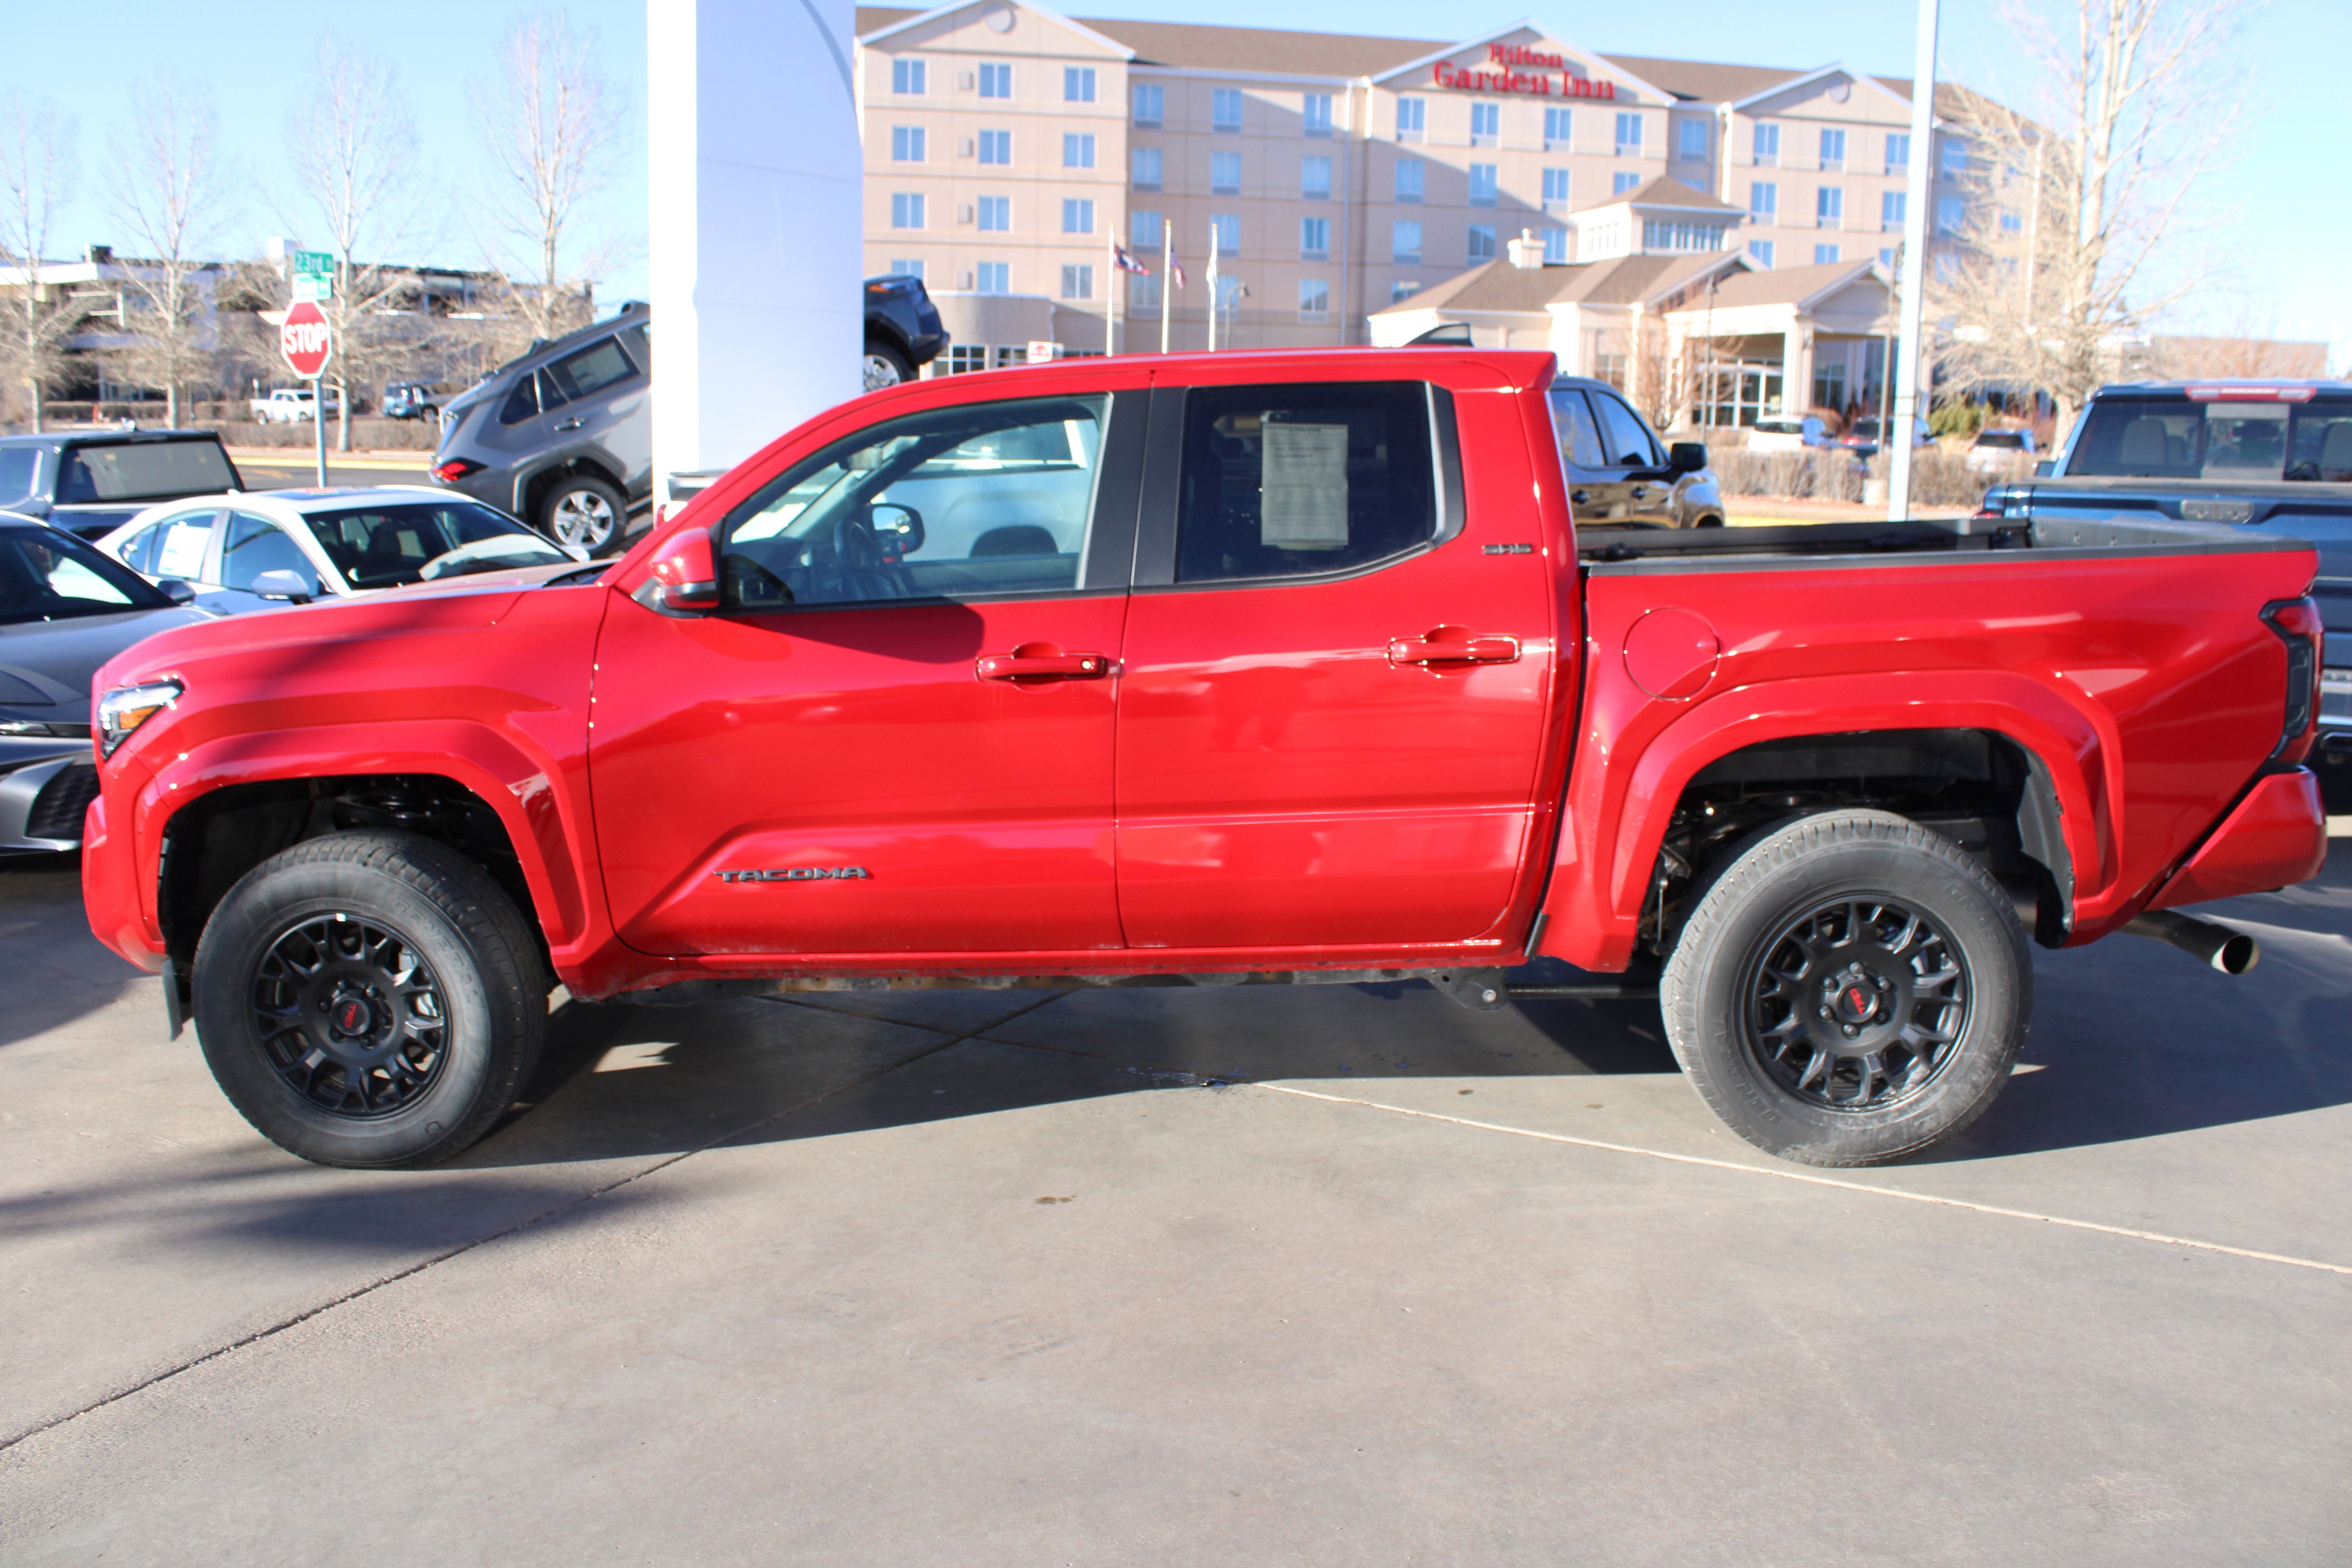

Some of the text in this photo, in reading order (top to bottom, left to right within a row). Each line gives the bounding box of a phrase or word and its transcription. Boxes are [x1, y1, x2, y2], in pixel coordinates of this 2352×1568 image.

[1489, 43, 1564, 68] Hilton
[1432, 60, 1615, 99] Garden Inn
[296, 253, 323, 272] 23rd
[286, 323, 327, 354] STOP
[713, 866, 867, 882] TACOMA
[394, 898, 477, 1004] GENERAL
[1849, 988, 1866, 1015] TRD
[344, 1004, 357, 1029] TRD
